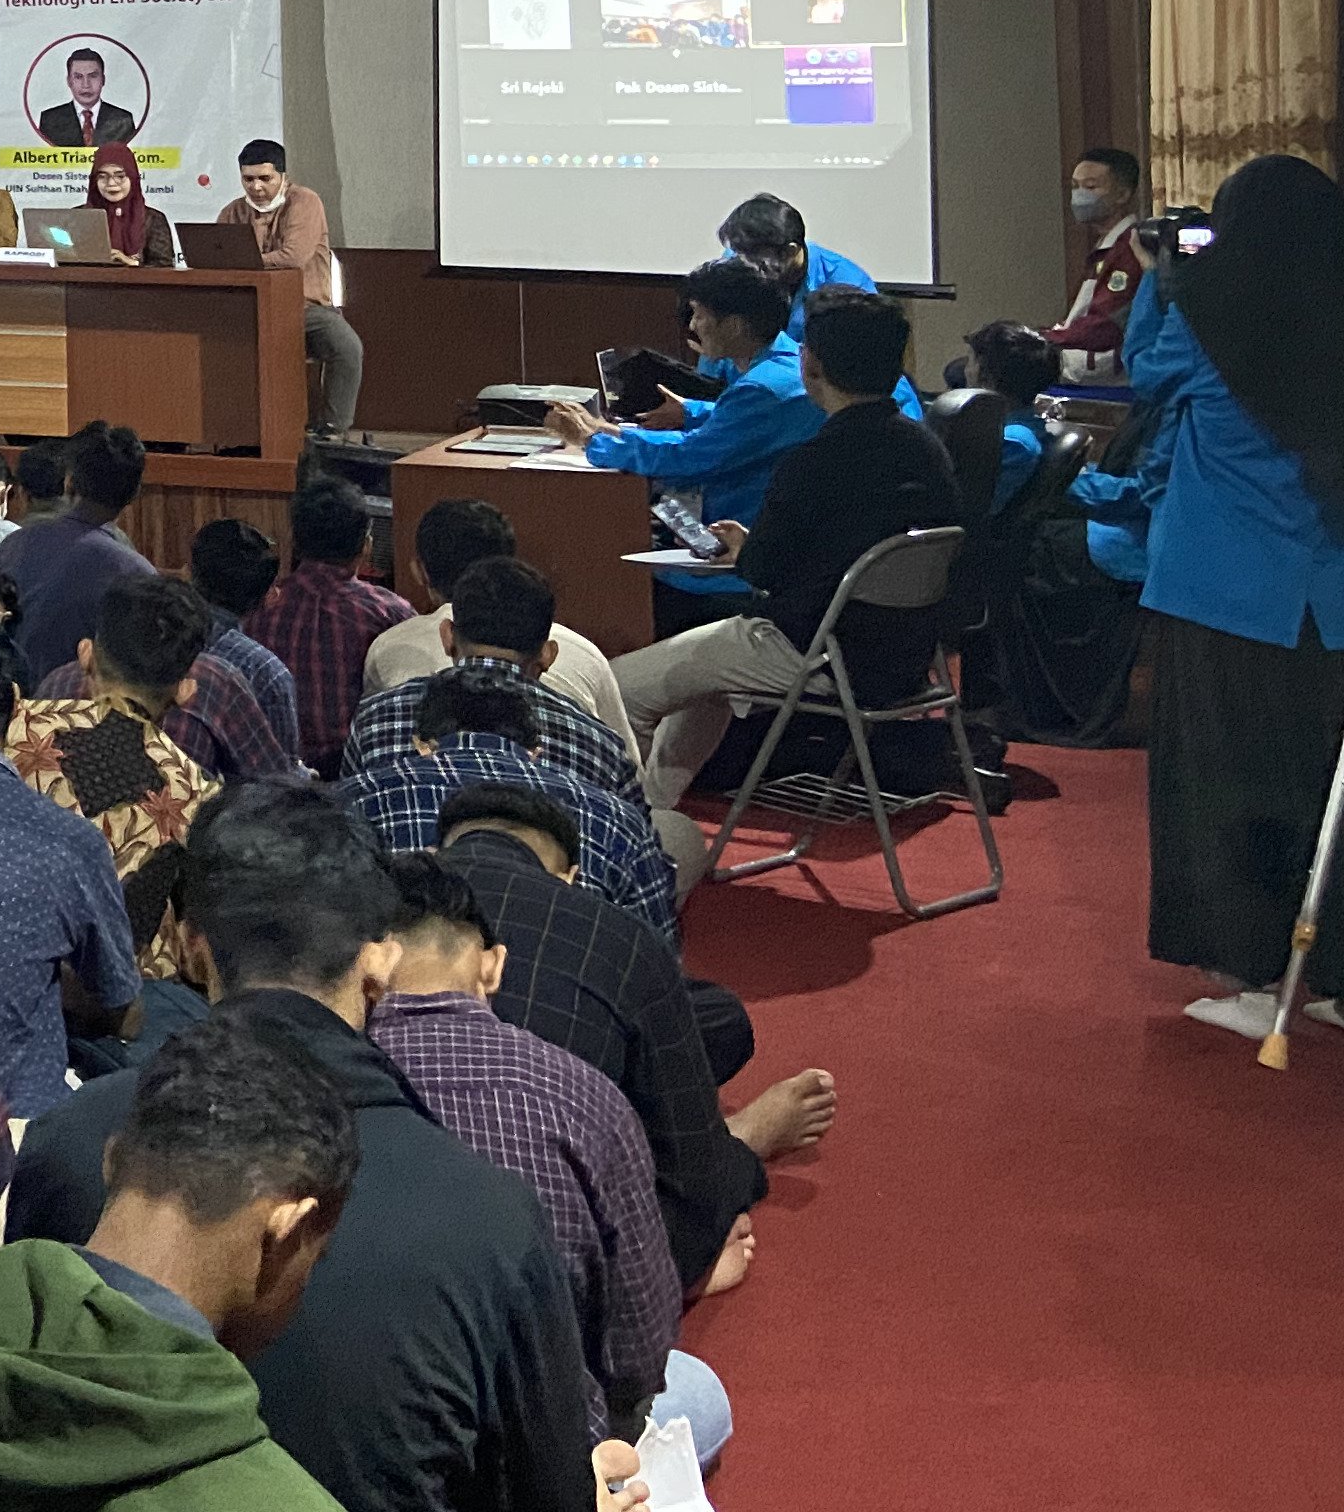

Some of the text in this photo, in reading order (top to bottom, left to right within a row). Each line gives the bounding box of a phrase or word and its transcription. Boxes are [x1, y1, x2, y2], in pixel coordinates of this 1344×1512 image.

[13, 151, 58, 164] Albert
[65, 172, 90, 180] Siste
[145, 185, 174, 193] Jambi
